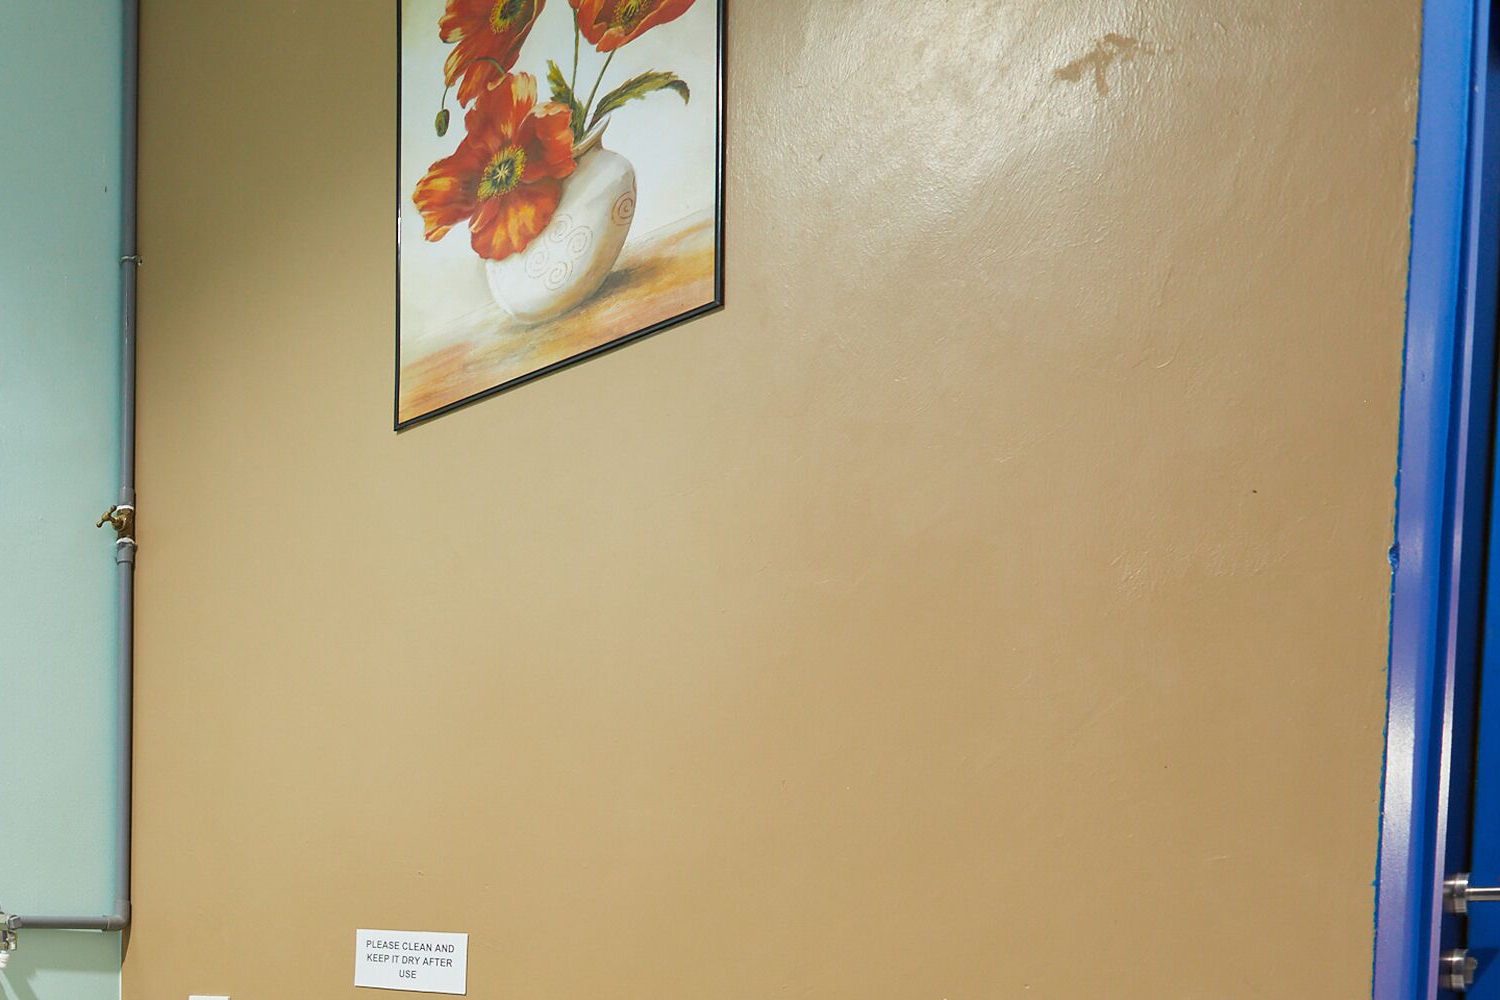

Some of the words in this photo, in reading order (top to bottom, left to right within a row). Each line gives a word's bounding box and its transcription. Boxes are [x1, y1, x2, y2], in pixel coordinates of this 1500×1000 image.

[366, 939, 400, 950] PLEASE
[402, 941, 432, 952] CLEAN
[434, 944, 455, 953] AND
[366, 953, 390, 963] KEEP
[392, 955, 400, 963] IT
[401, 955, 421, 965] DRY
[422, 957, 453, 968] AFTER
[399, 969, 417, 979] USE
